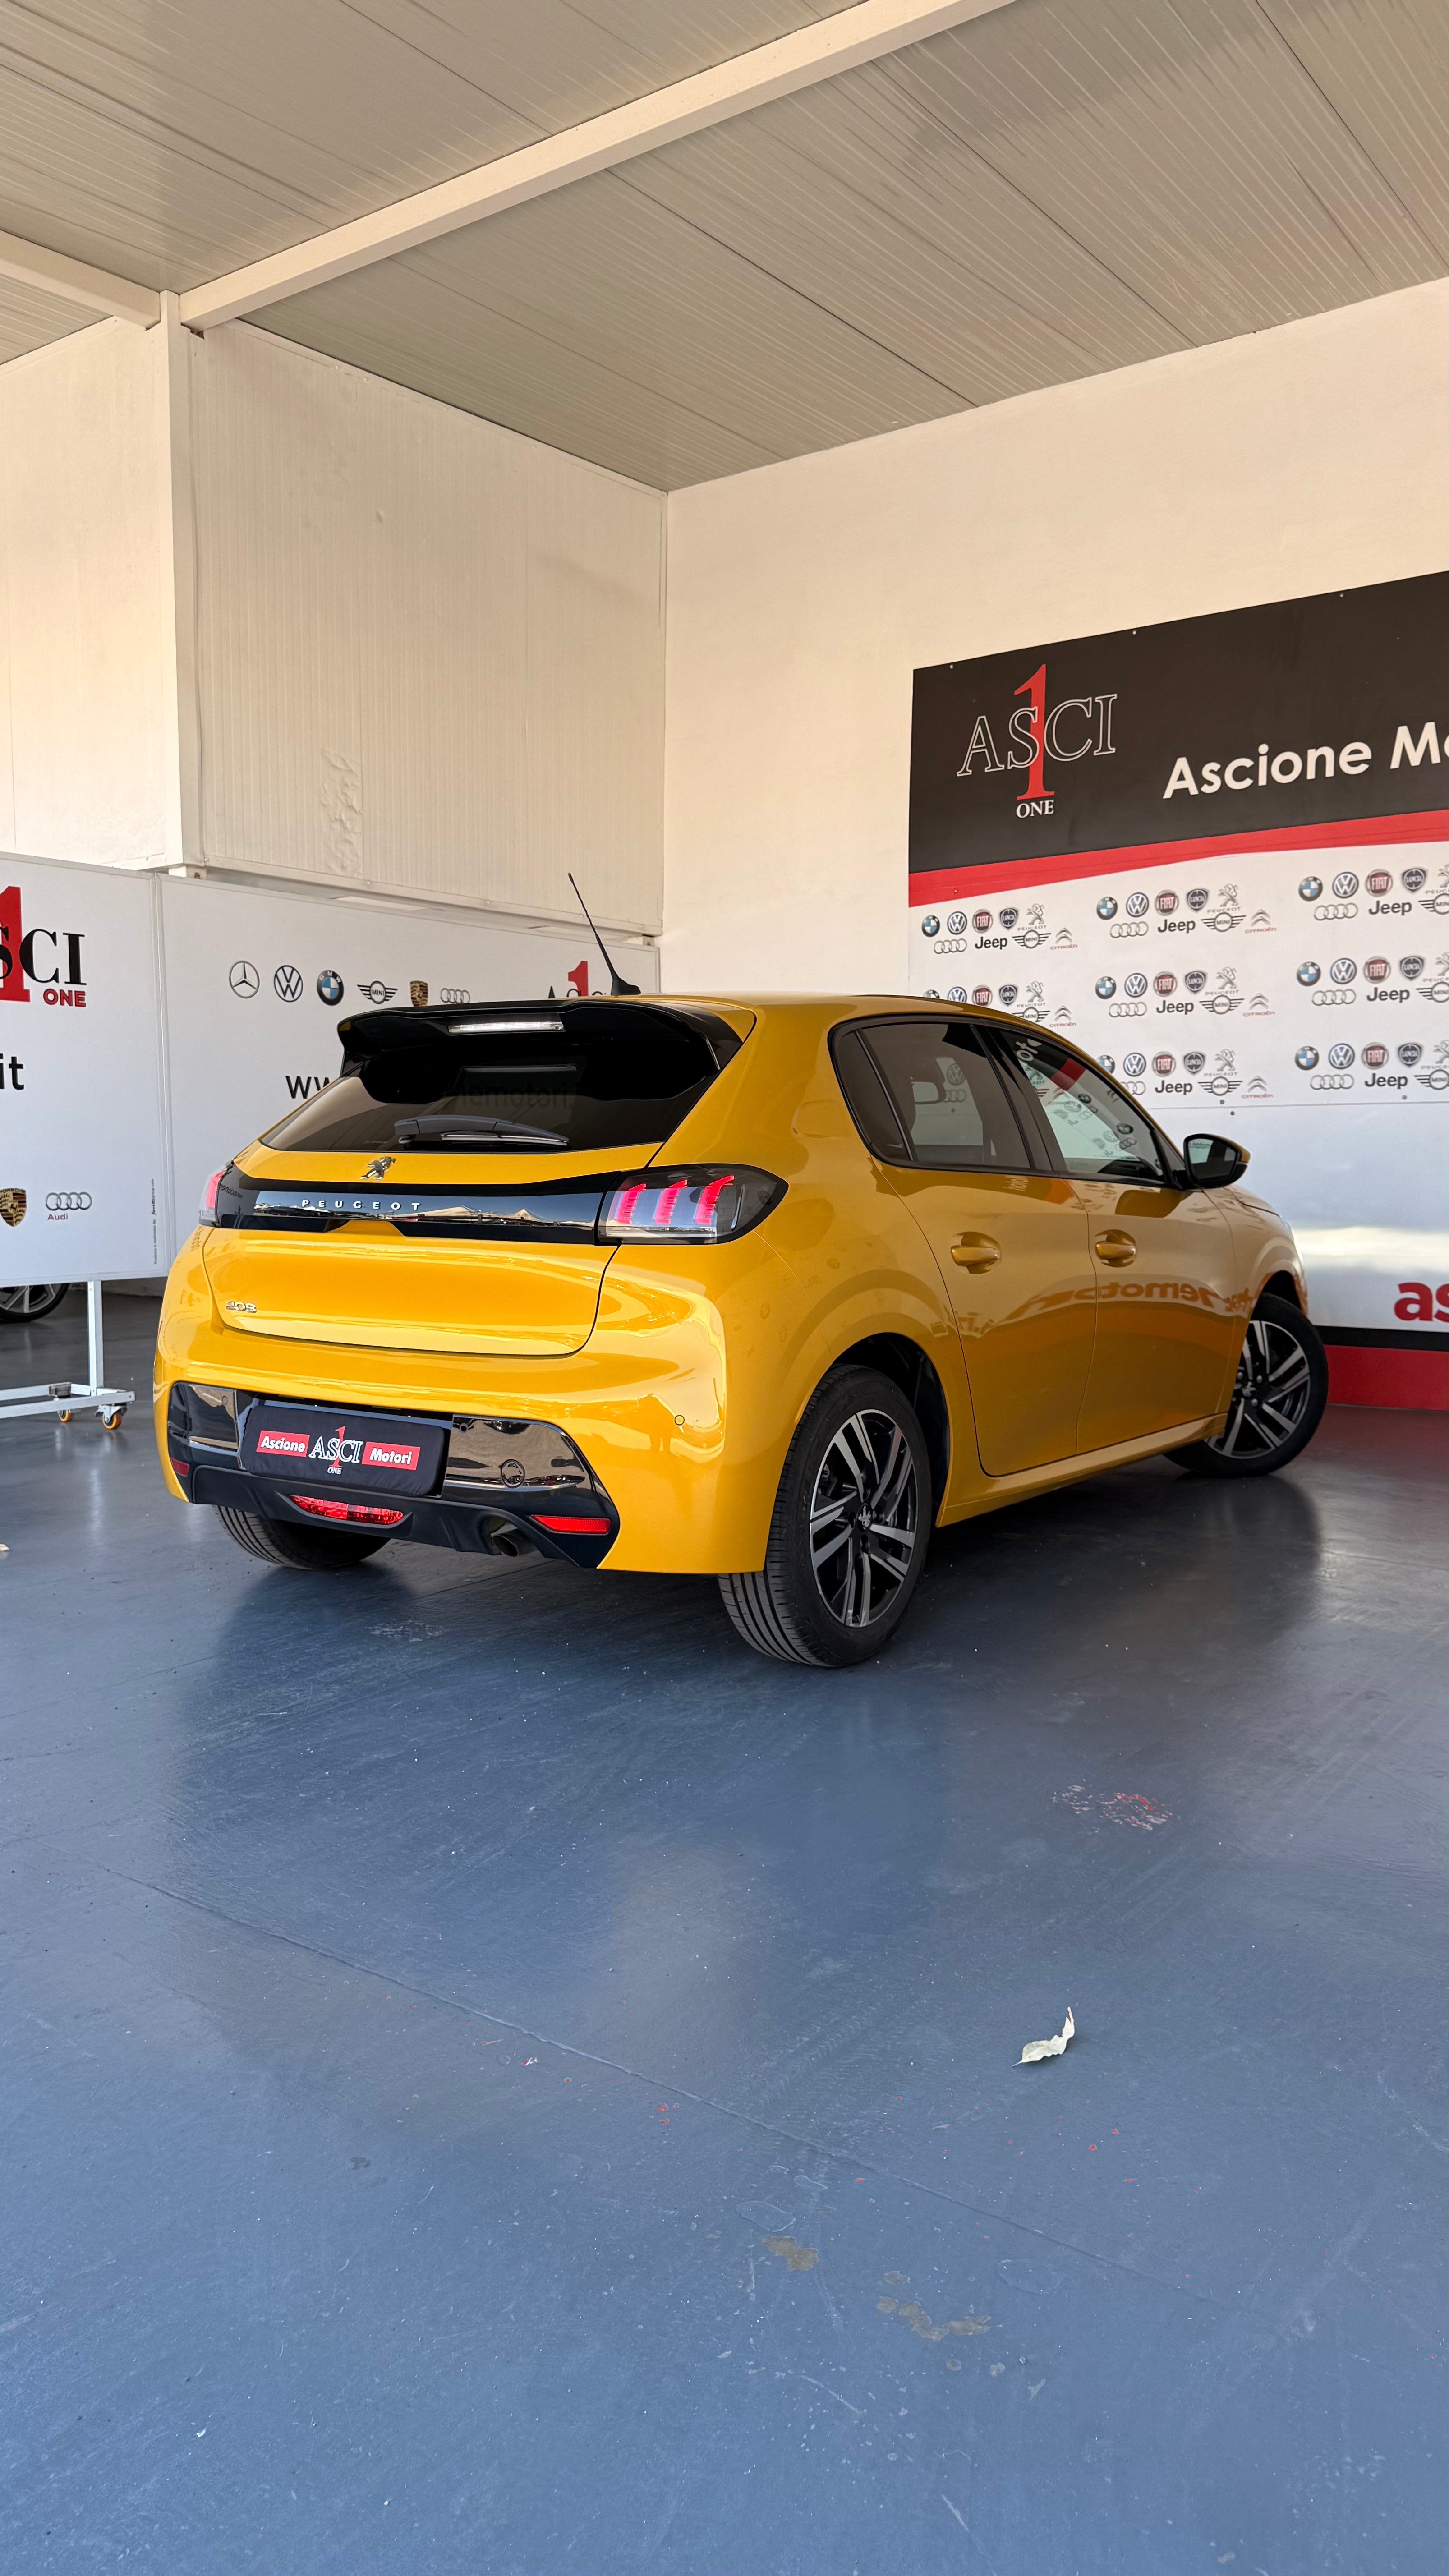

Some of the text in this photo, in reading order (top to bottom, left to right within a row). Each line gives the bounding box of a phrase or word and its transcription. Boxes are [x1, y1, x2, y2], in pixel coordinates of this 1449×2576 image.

[957, 694, 1117, 777] ASCI
[1163, 722, 1449, 799] Ascione M
[1016, 800, 1054, 818] ONE
[1371, 876, 1388, 890] FIAT
[1159, 896, 1174, 909] FIAT
[1368, 901, 1412, 915] Jeep
[976, 915, 989, 929] FIAT
[1157, 919, 1196, 933] Jeep
[975, 937, 1007, 949] Jeep
[319, 971, 341, 983] BMW
[1369, 964, 1386, 977] FIAT
[1158, 978, 1173, 991] FIAT
[43, 988, 86, 1007] ONE
[976, 992, 989, 1003] FIAT
[1366, 987, 1410, 1003] Jeep
[1156, 1000, 1194, 1015] Jeep
[1367, 1049, 1384, 1063] FIAT
[1157, 1059, 1172, 1071] FIAT
[1155, 1080, 1192, 1095] Jeep
[1365, 1073, 1408, 1089] Jeep
[302, 1199, 420, 1210] PEUGEOT
[226, 1301, 257, 1313] 208
[260, 1436, 412, 1464] Ascione ASCI Motori
[327, 1467, 342, 1475] ONE
